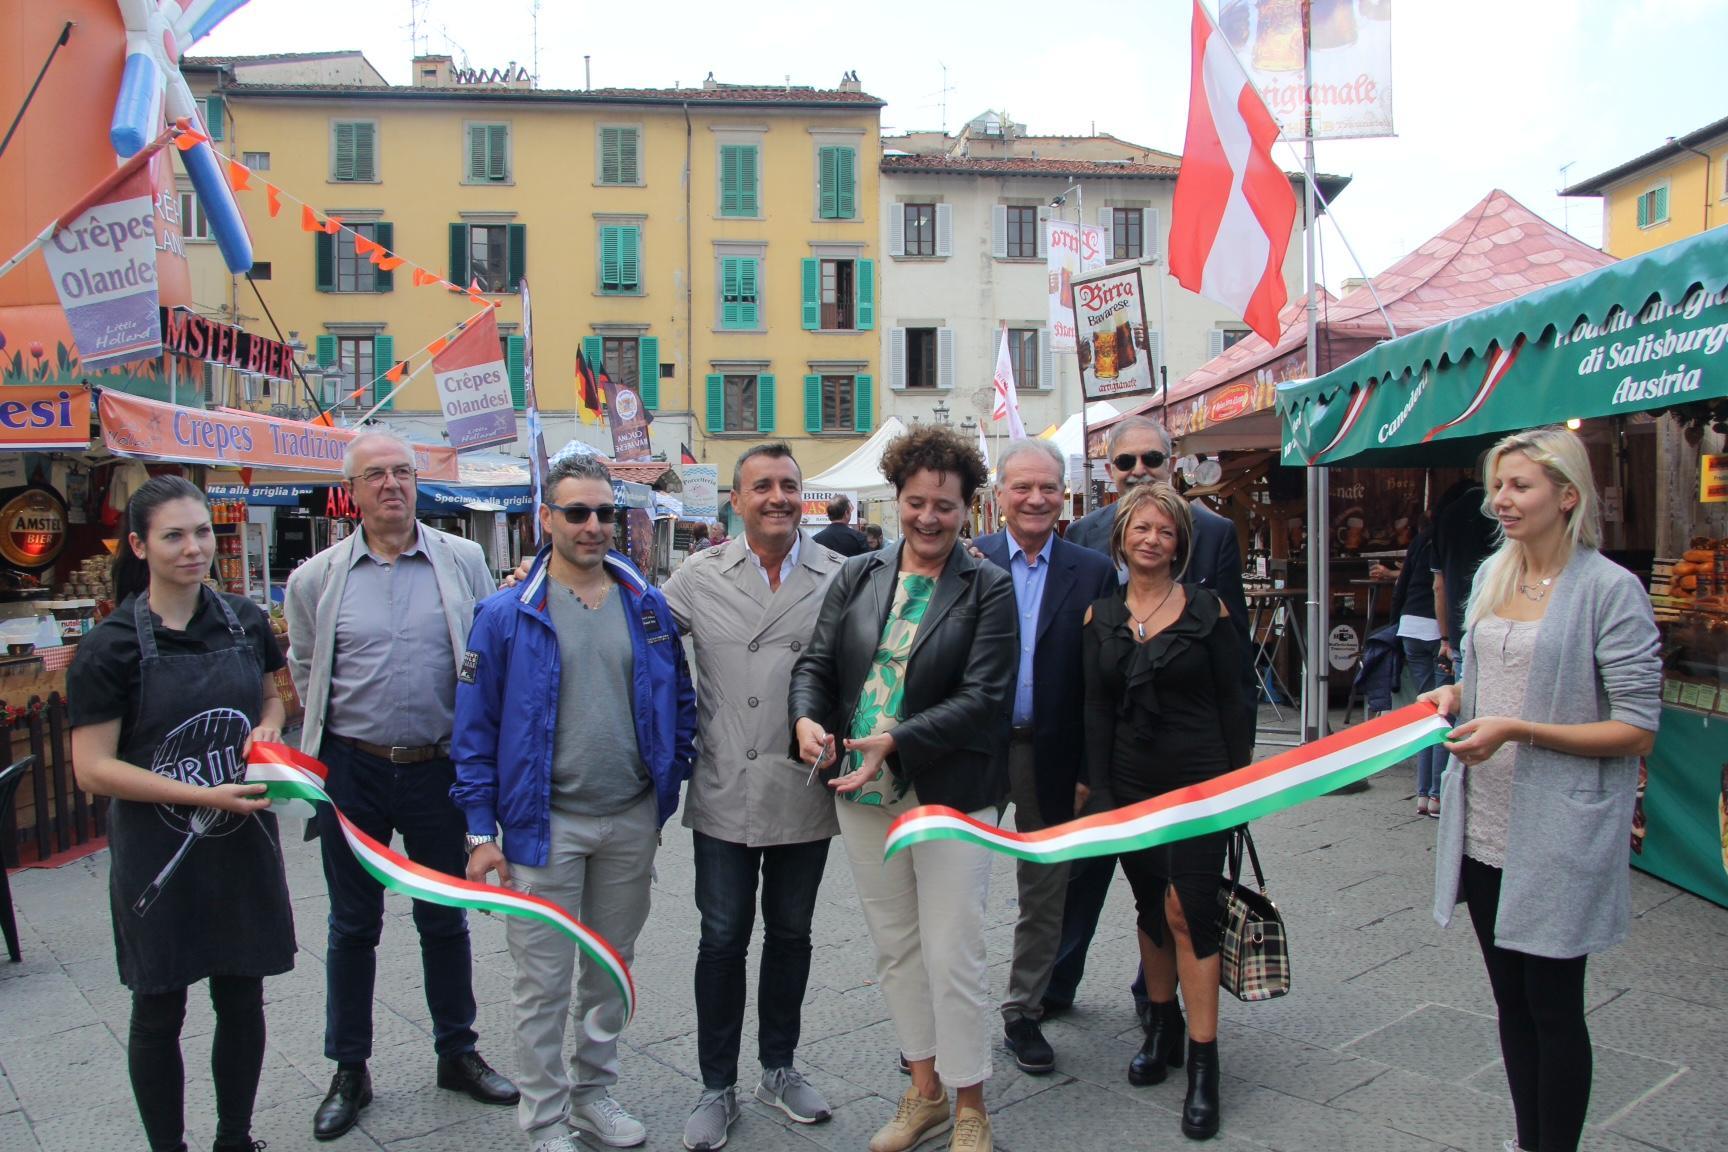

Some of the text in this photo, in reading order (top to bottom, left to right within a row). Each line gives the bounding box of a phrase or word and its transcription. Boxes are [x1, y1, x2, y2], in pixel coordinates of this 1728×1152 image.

[53, 214, 154, 254] Crêpes
[61, 257, 157, 300] Olande
[1079, 281, 1134, 312] Birra
[1087, 299, 1130, 327] Bavarese
[95, 327, 152, 349] Holland
[165, 307, 294, 381] MSTEL BIER
[1578, 347, 1604, 376] di
[444, 369, 501, 393] Crêpes
[1611, 364, 1702, 405] Austria
[446, 389, 509, 416] Olandesi
[269, 423, 350, 463] Tradizion
[229, 486, 249, 495] alla
[252, 487, 289, 498] griglia
[502, 495, 533, 506] griglia
[16, 516, 61, 531] AMSTEL
[27, 534, 53, 545] BIER
